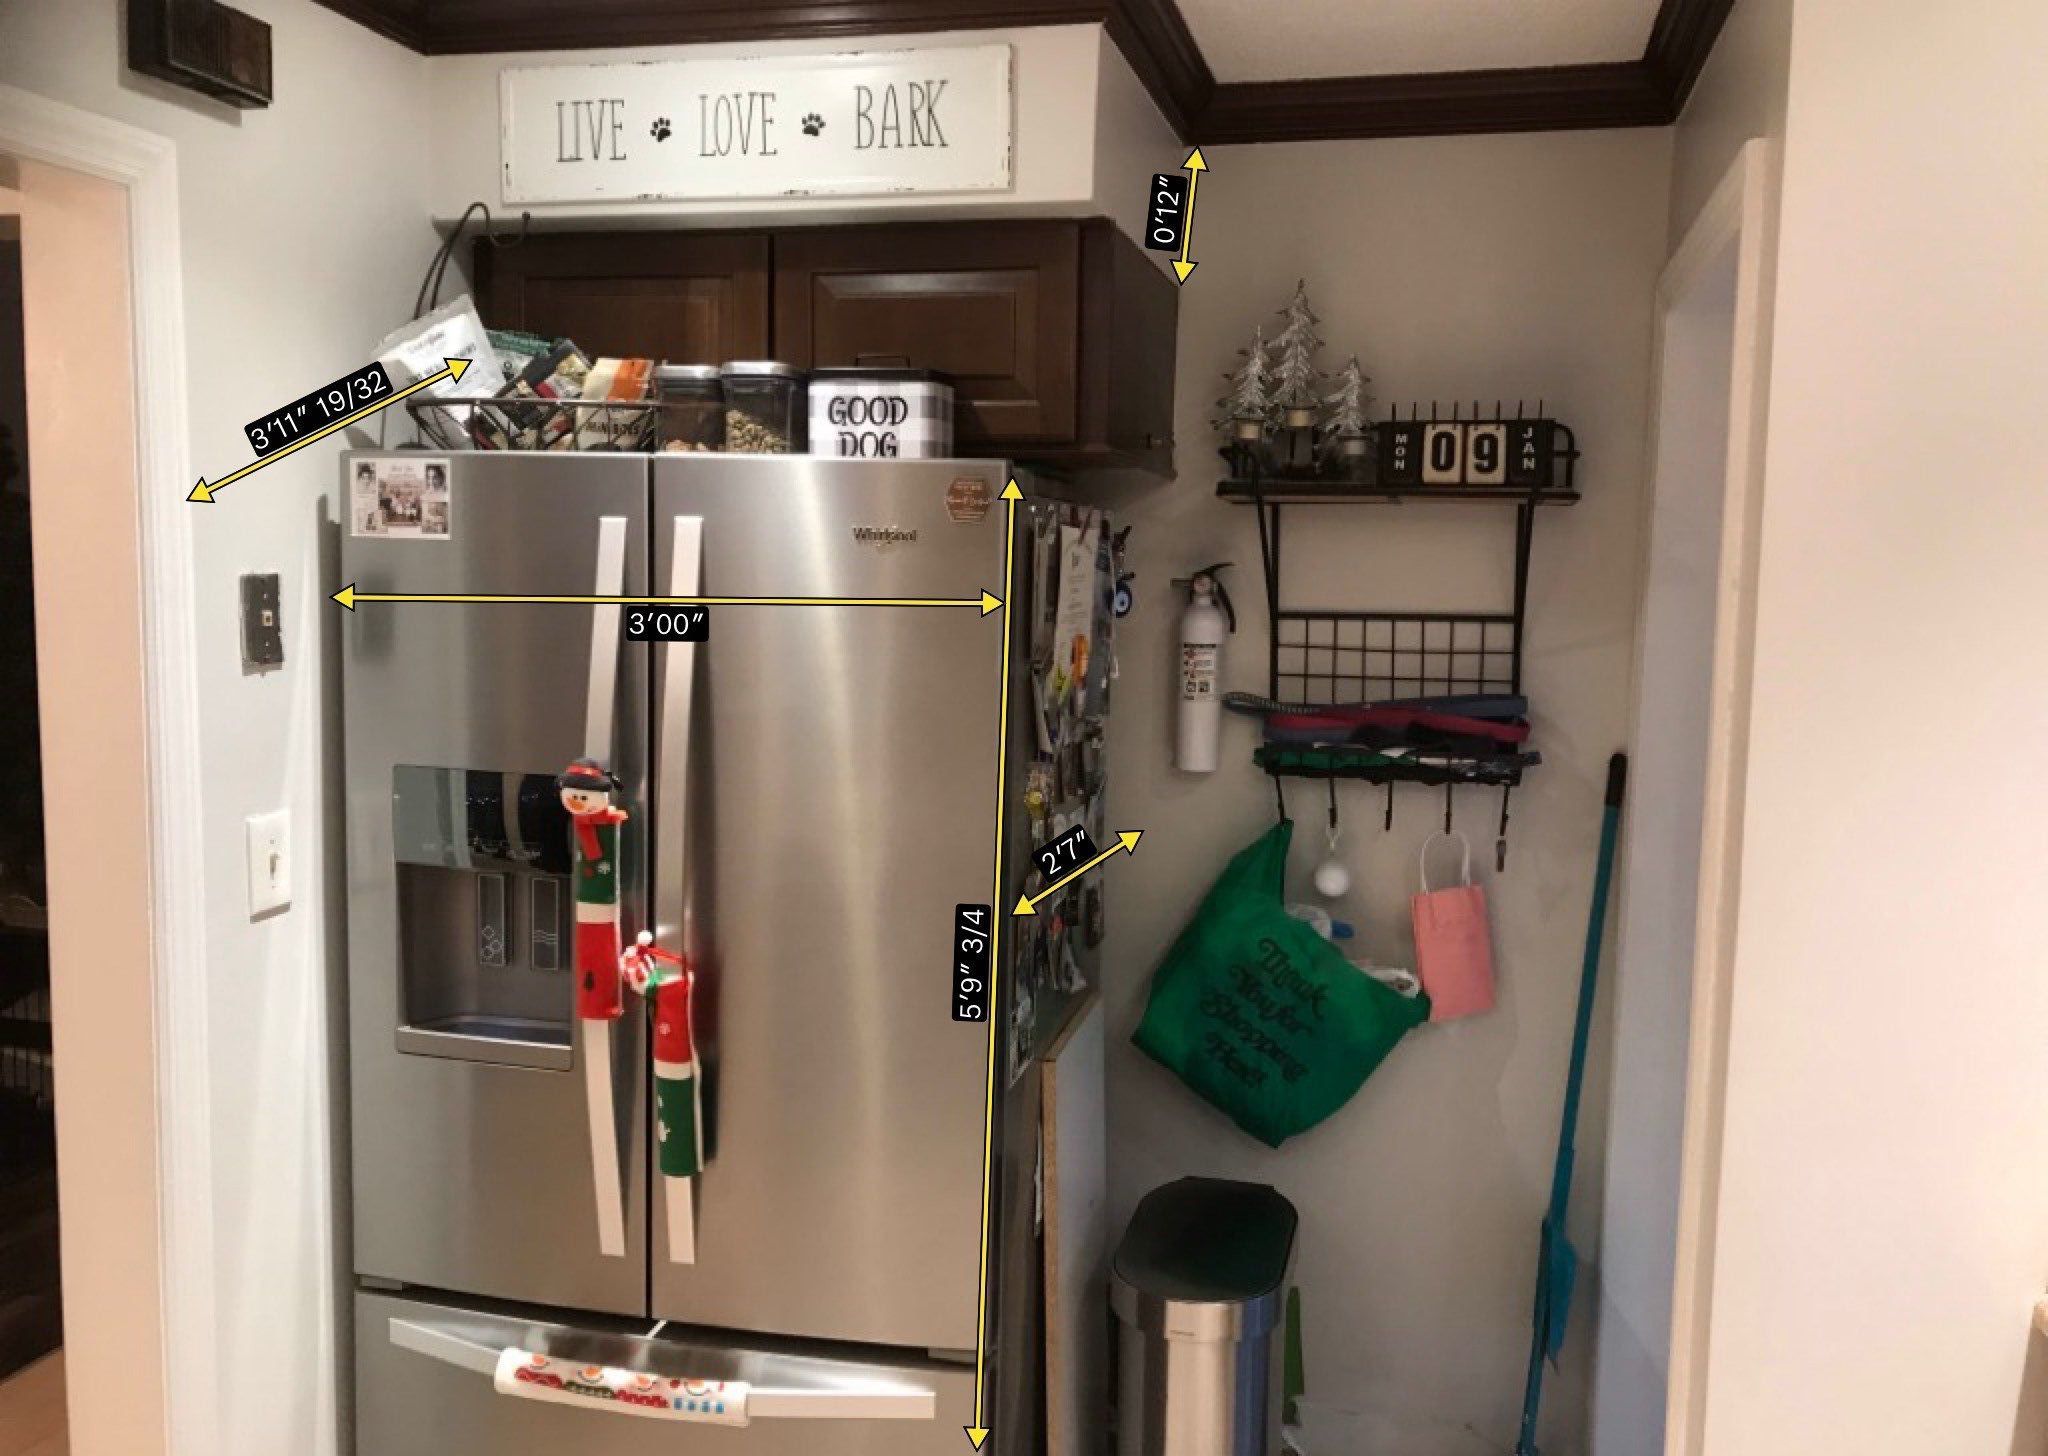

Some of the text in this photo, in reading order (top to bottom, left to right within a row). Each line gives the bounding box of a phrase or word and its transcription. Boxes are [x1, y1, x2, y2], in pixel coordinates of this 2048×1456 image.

[556, 79, 949, 162] LIVE LOVE BARK
[828, 396, 908, 426] GOOD
[836, 431, 897, 458] DOG
[1521, 427, 1536, 470] JAN
